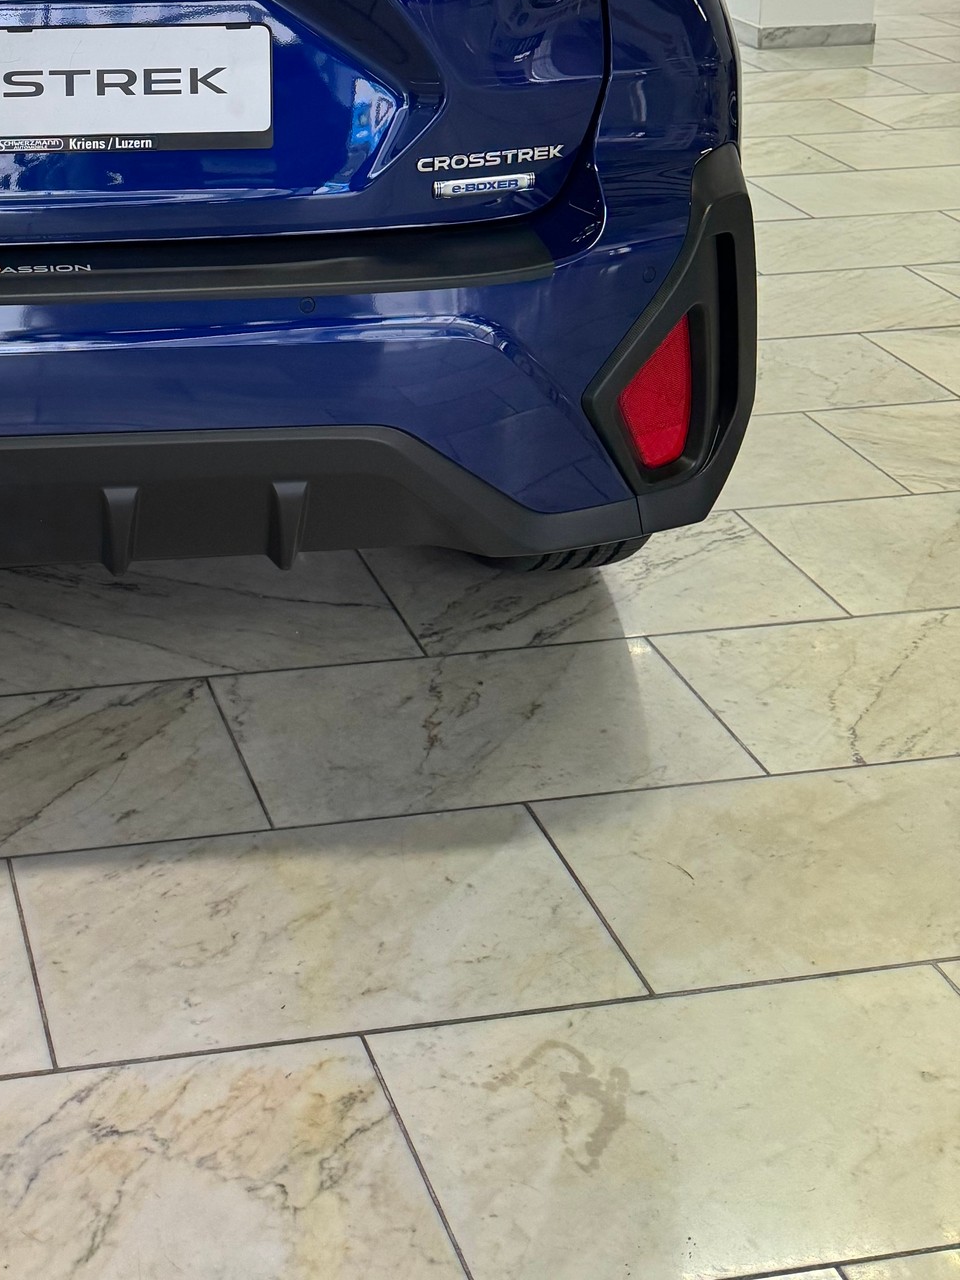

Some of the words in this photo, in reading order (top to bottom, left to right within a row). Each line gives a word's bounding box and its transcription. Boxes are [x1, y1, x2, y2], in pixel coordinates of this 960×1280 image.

[69, 137, 106, 150] Kriens
[115, 137, 152, 149] Luzern
[417, 144, 565, 172] CROSSTREK
[451, 179, 519, 193] e-BOXER
